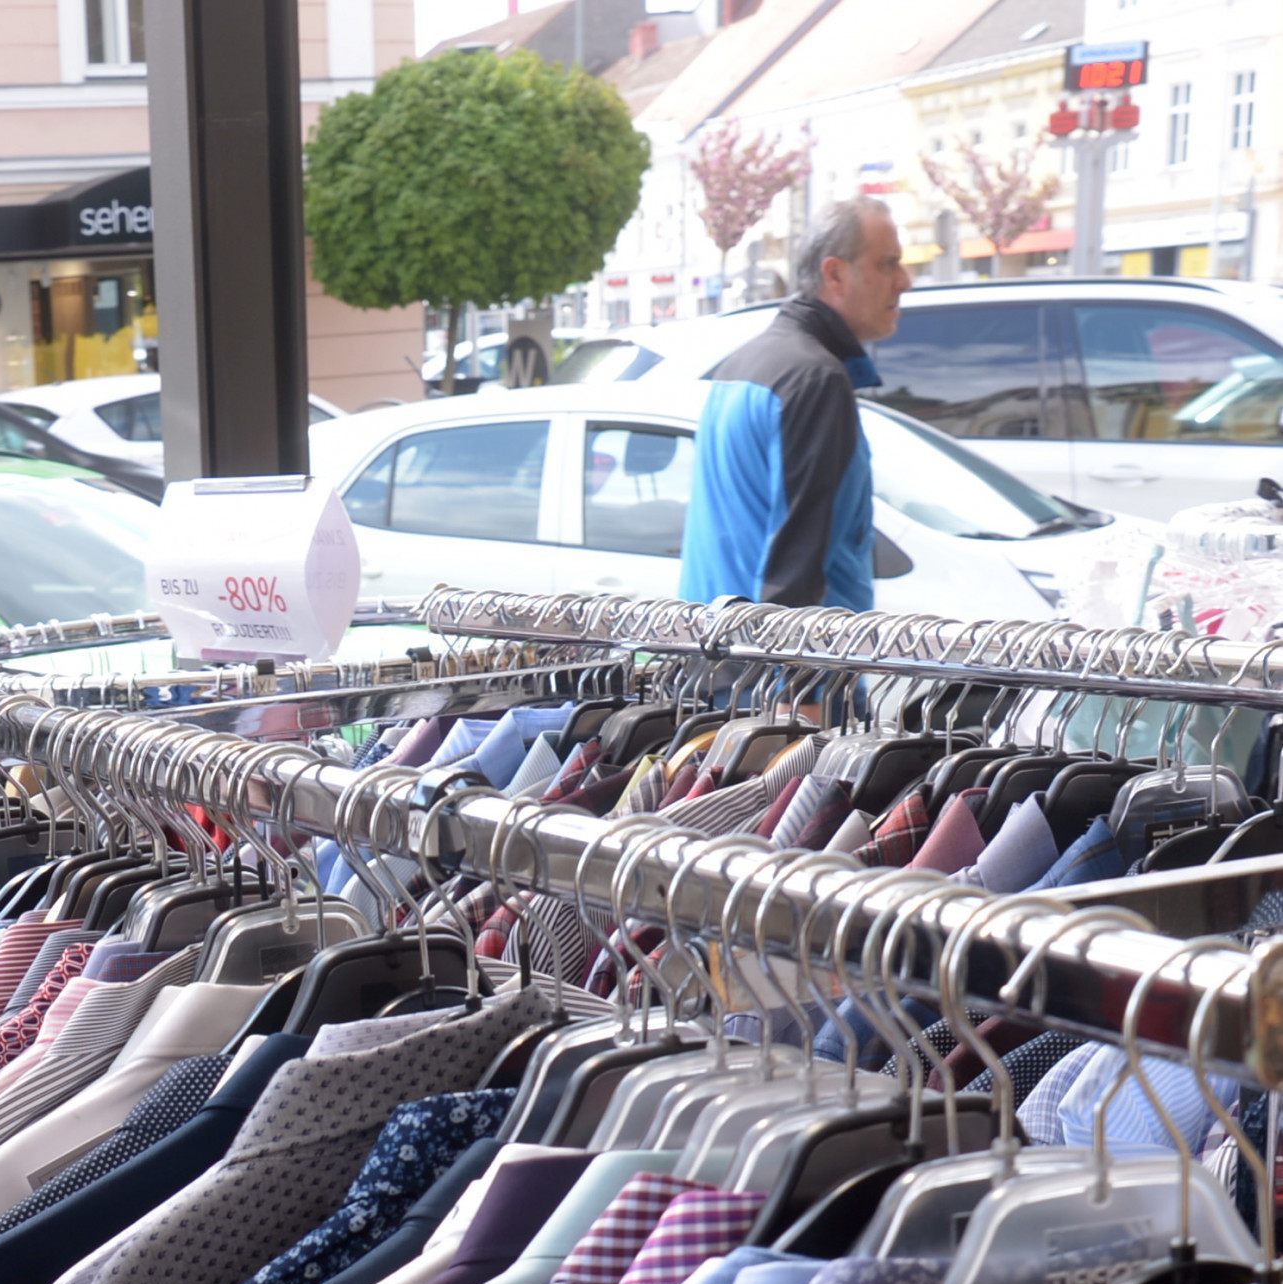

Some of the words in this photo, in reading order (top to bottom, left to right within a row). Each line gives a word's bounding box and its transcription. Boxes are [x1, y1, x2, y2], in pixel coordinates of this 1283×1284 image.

[160, 578, 182, 596] BIS
[183, 578, 199, 596] ZU
[218, 575, 287, 613] -80%
